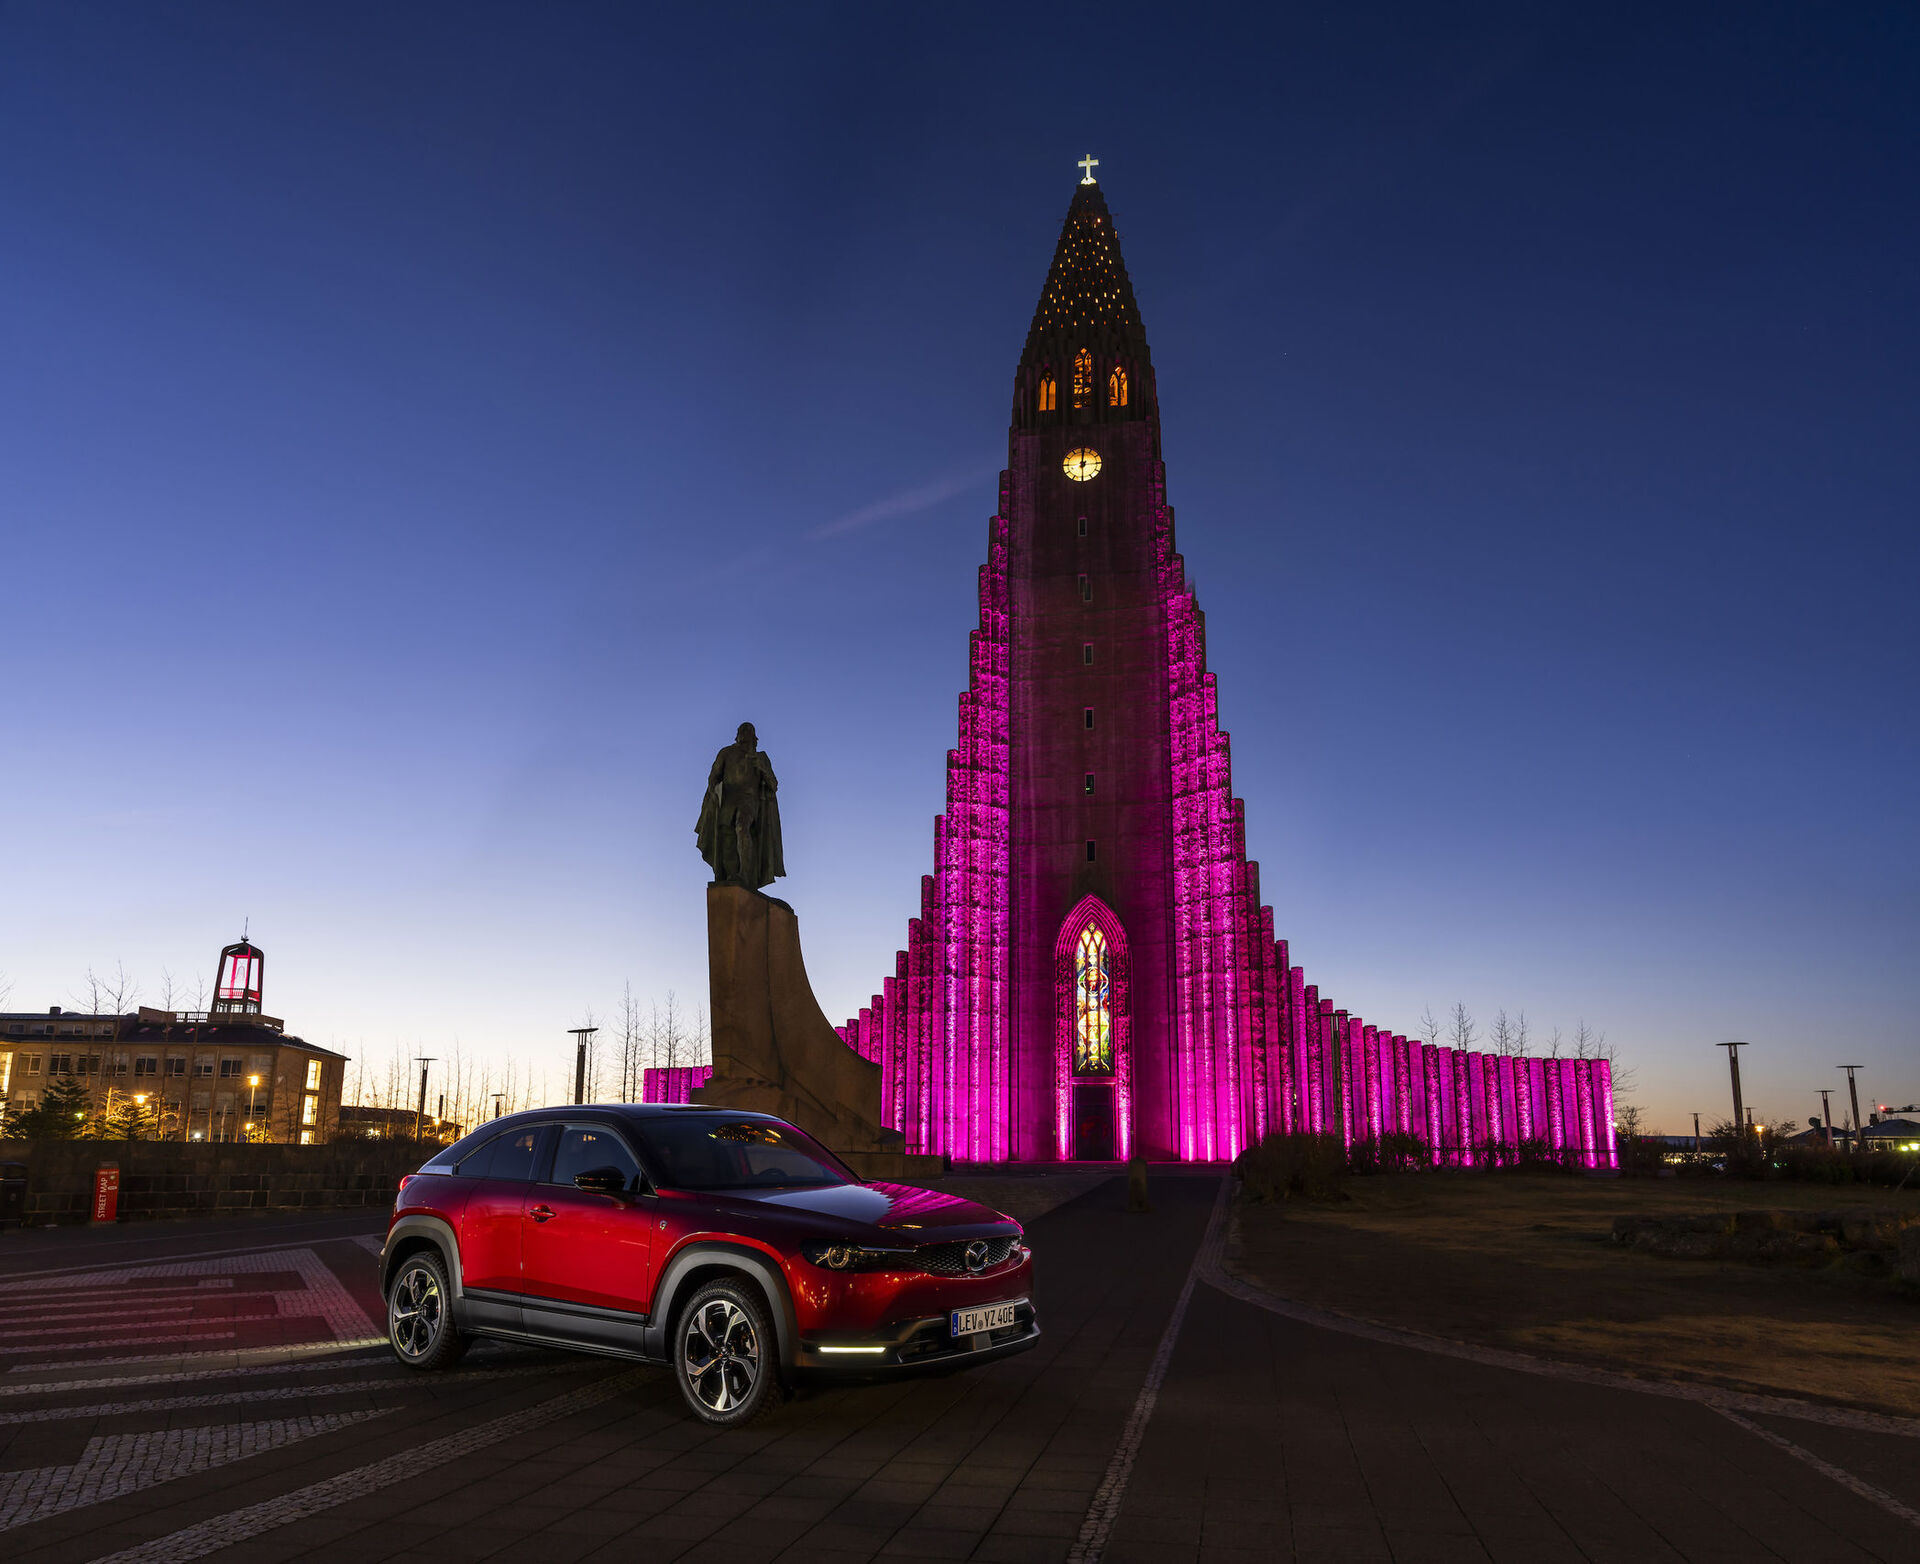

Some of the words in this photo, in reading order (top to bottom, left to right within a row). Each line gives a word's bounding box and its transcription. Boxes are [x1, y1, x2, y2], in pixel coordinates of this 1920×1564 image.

[100, 1177, 108, 1193] MAP
[97, 1194, 107, 1218] STREET
[959, 1313, 977, 1332] LEV
[984, 1309, 996, 1327] YZ
